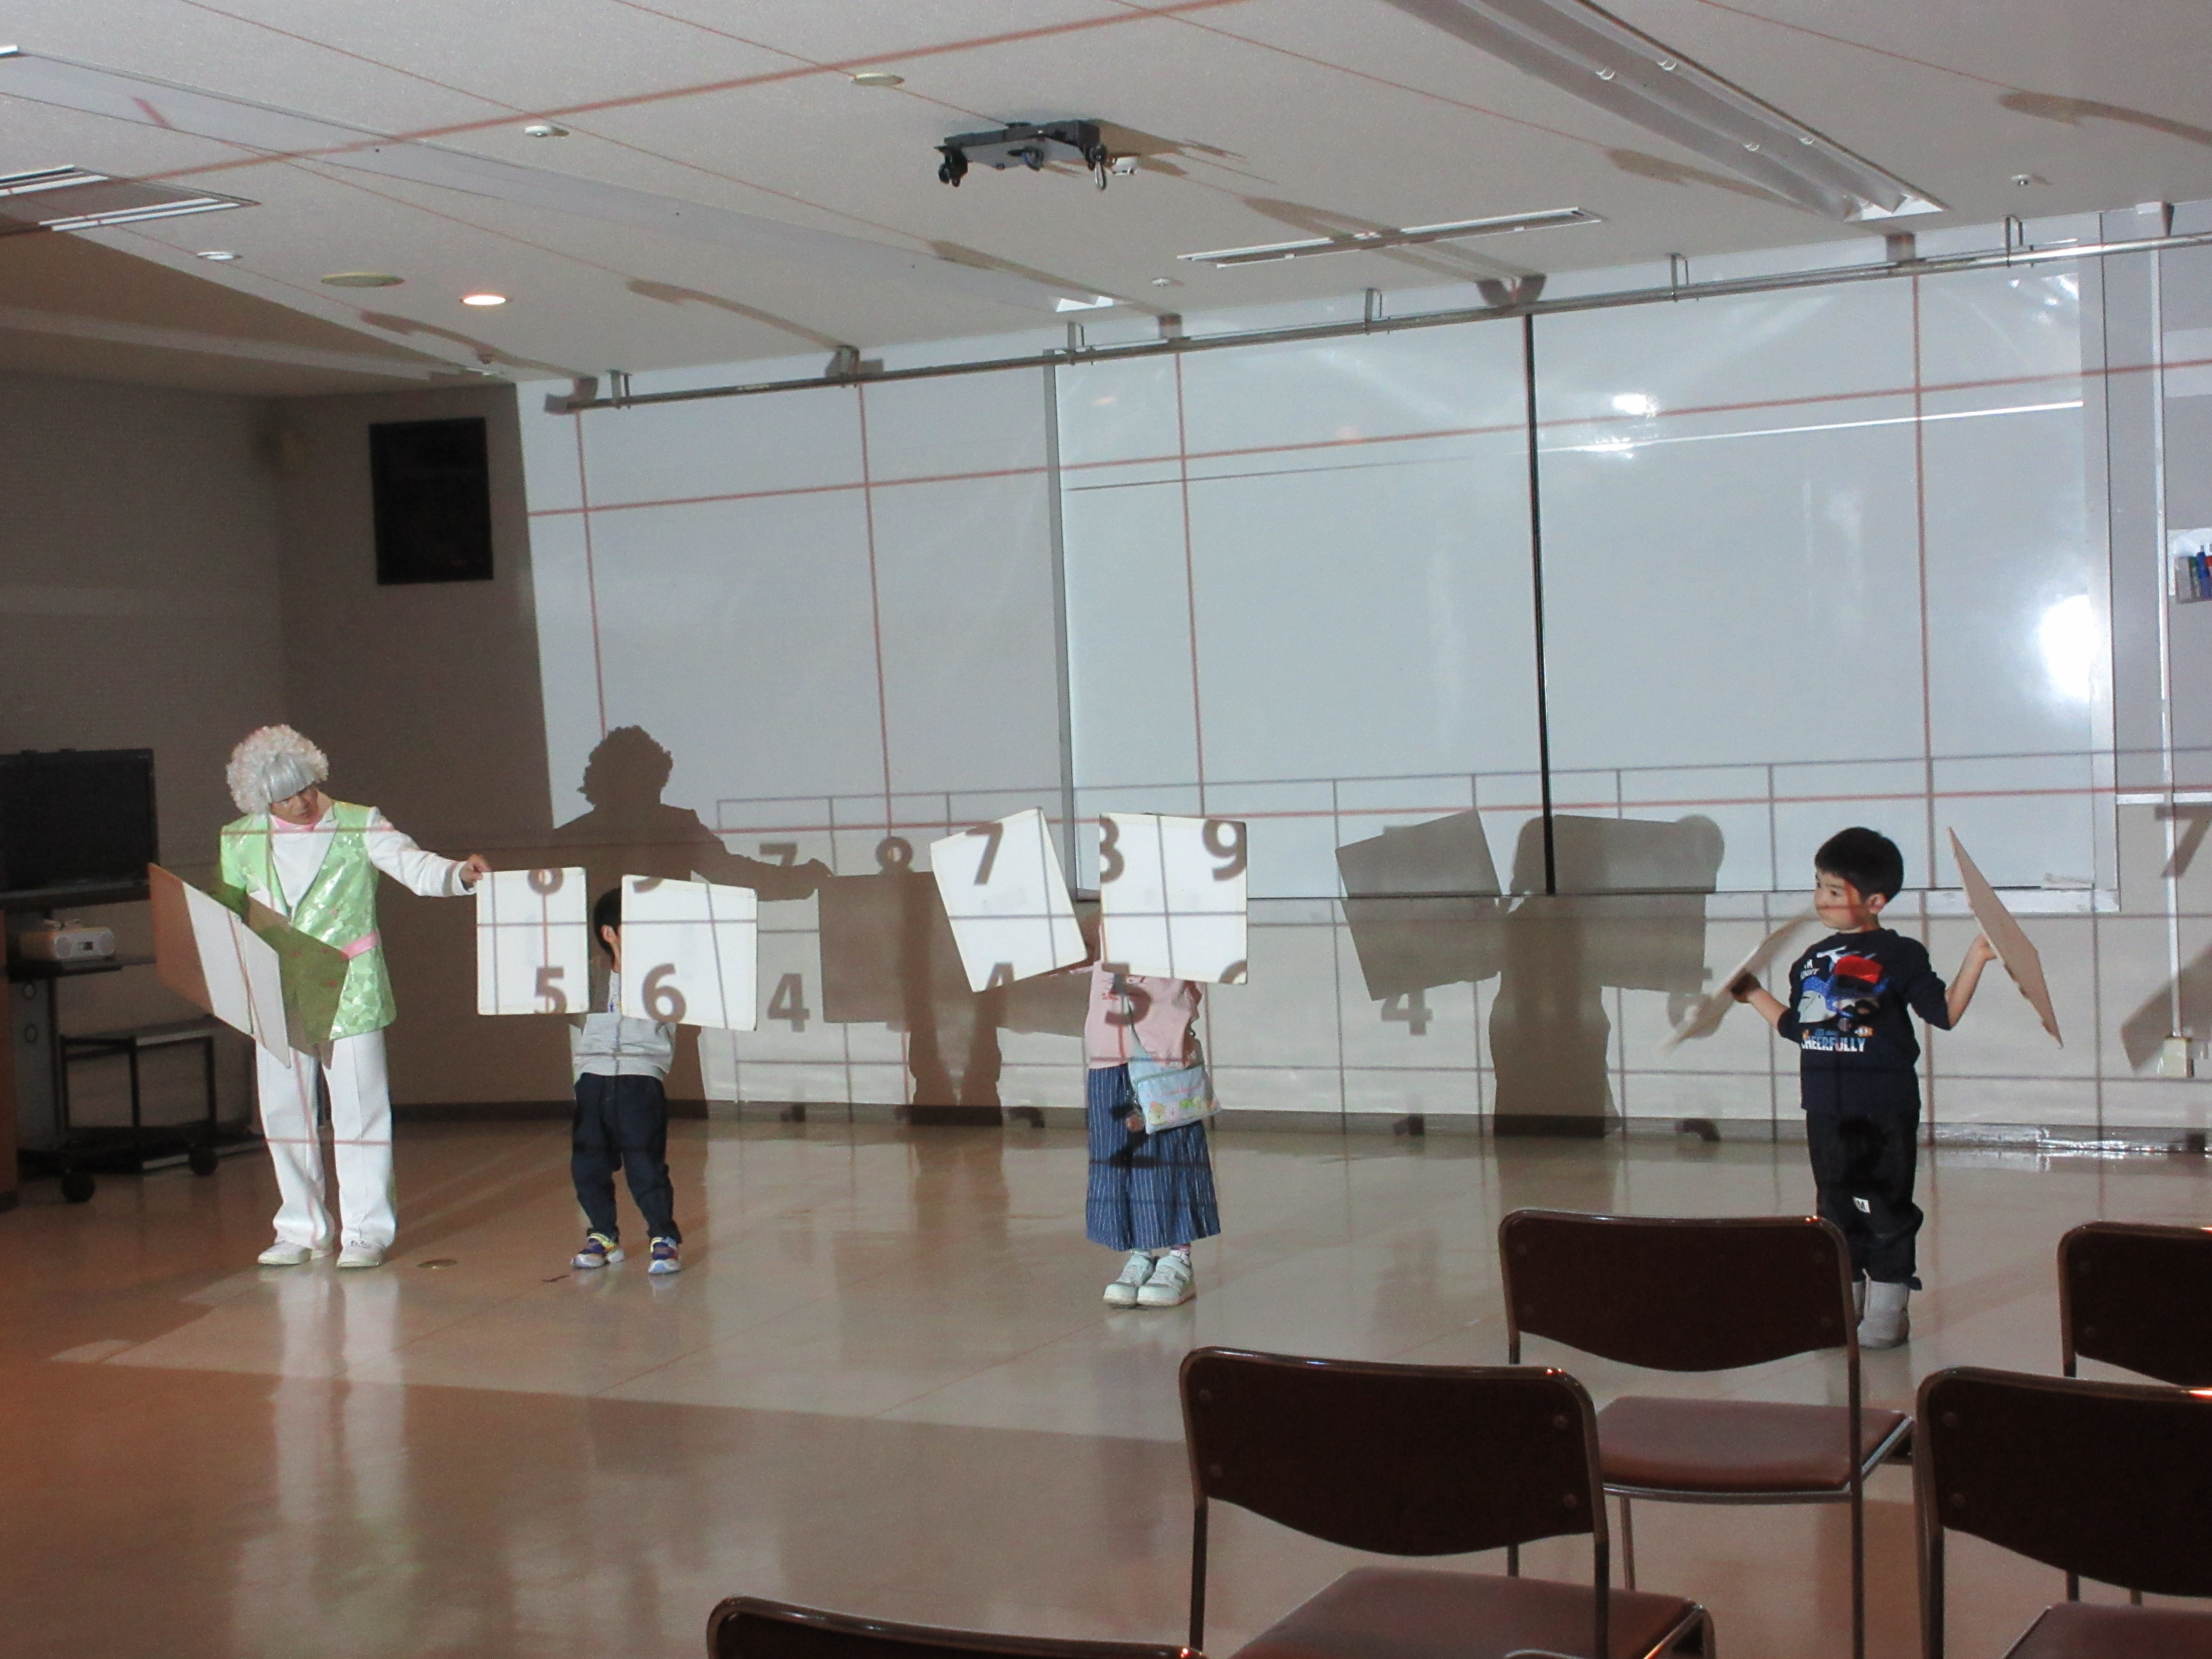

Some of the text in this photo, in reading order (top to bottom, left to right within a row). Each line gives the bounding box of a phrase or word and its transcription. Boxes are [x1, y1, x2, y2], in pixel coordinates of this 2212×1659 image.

[966, 822, 1004, 885] 7
[1201, 819, 1247, 881] 9
[2155, 803, 2212, 879] 7
[536, 963, 687, 1023] 5 6
[768, 973, 810, 1032] 4
